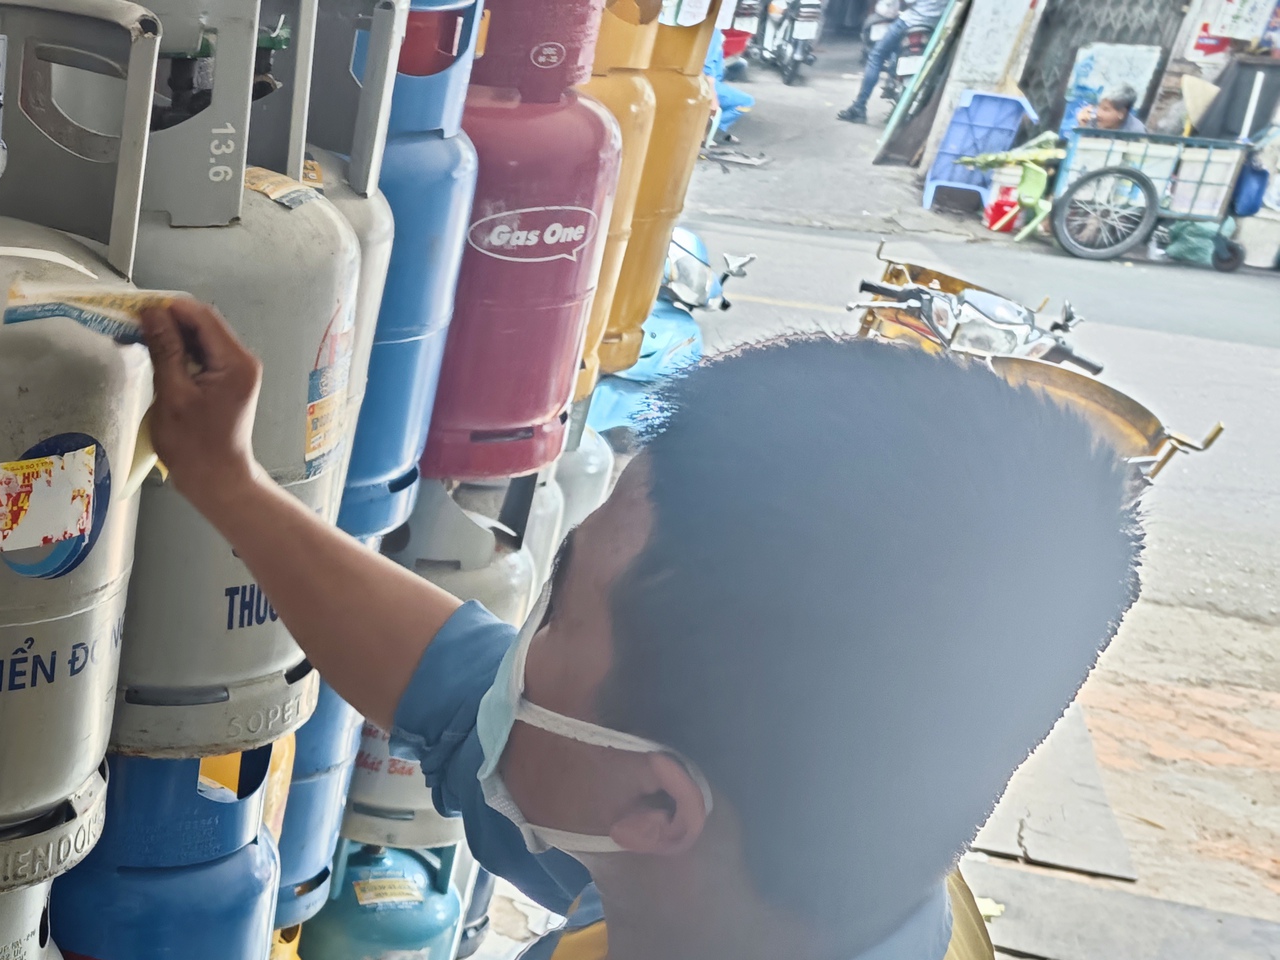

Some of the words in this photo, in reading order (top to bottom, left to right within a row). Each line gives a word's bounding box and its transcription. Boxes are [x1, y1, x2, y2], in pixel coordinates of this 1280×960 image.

[209, 122, 236, 182] 13.6
[489, 224, 540, 246] Gas
[543, 222, 585, 245] One
[226, 693, 303, 739] SOPET
